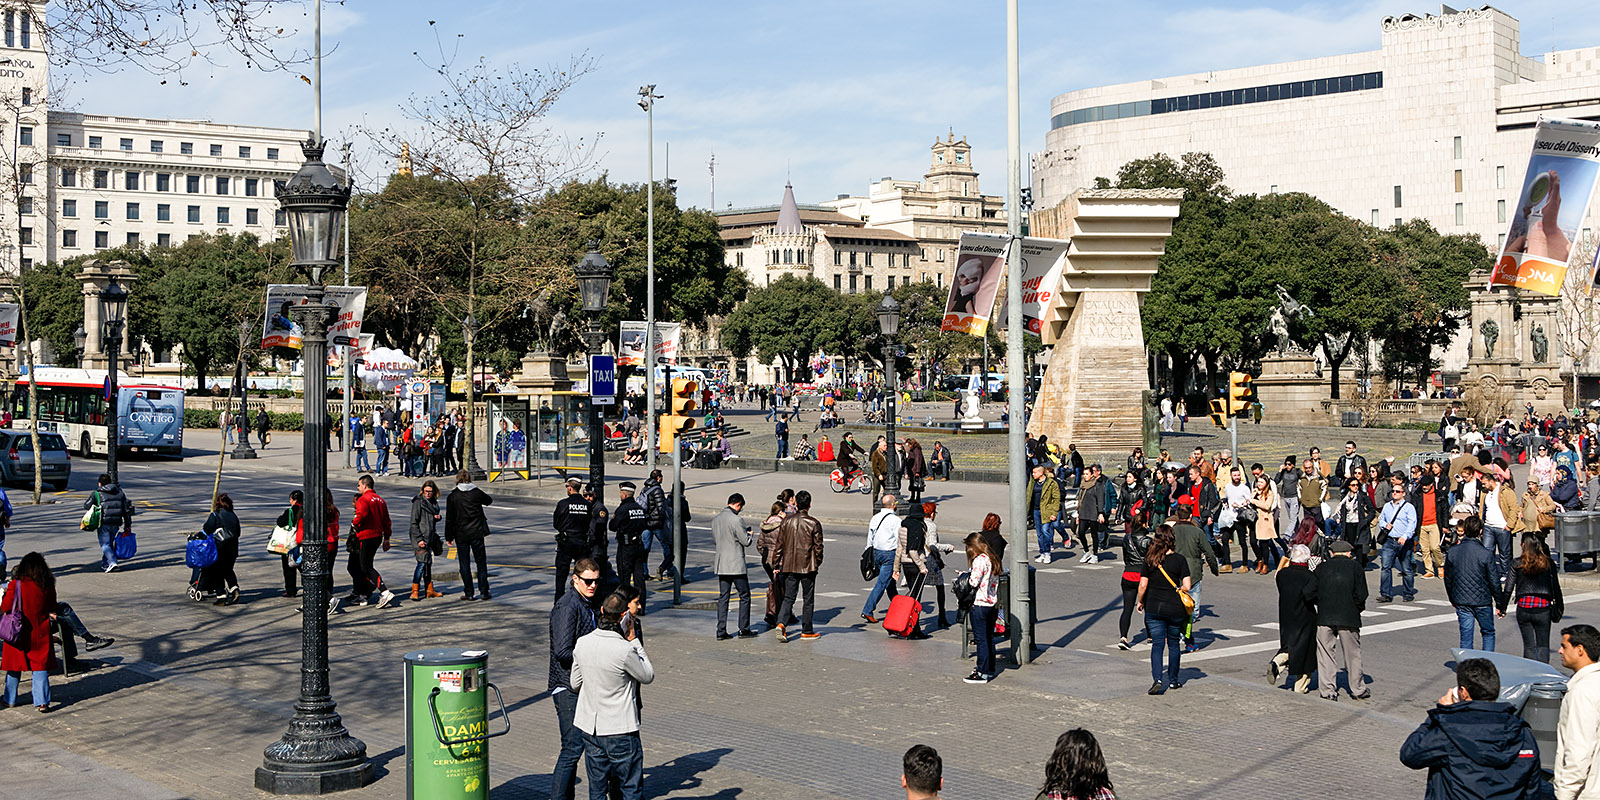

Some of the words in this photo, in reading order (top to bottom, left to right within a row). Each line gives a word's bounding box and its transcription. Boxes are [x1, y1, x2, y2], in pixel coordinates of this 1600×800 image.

[0, 58, 34, 69] AÑOL
[0, 69, 24, 79] DITO
[1554, 140, 1568, 152] del
[1567, 141, 1600, 158] Disseny
[1501, 273, 1528, 284] inspira
[1022, 291, 1050, 304] iure
[1084, 300, 1138, 310] CATALUNYA
[593, 369, 614, 383] TAXI
[568, 503, 588, 511] POLICIA
[439, 732, 488, 750] LEMO
